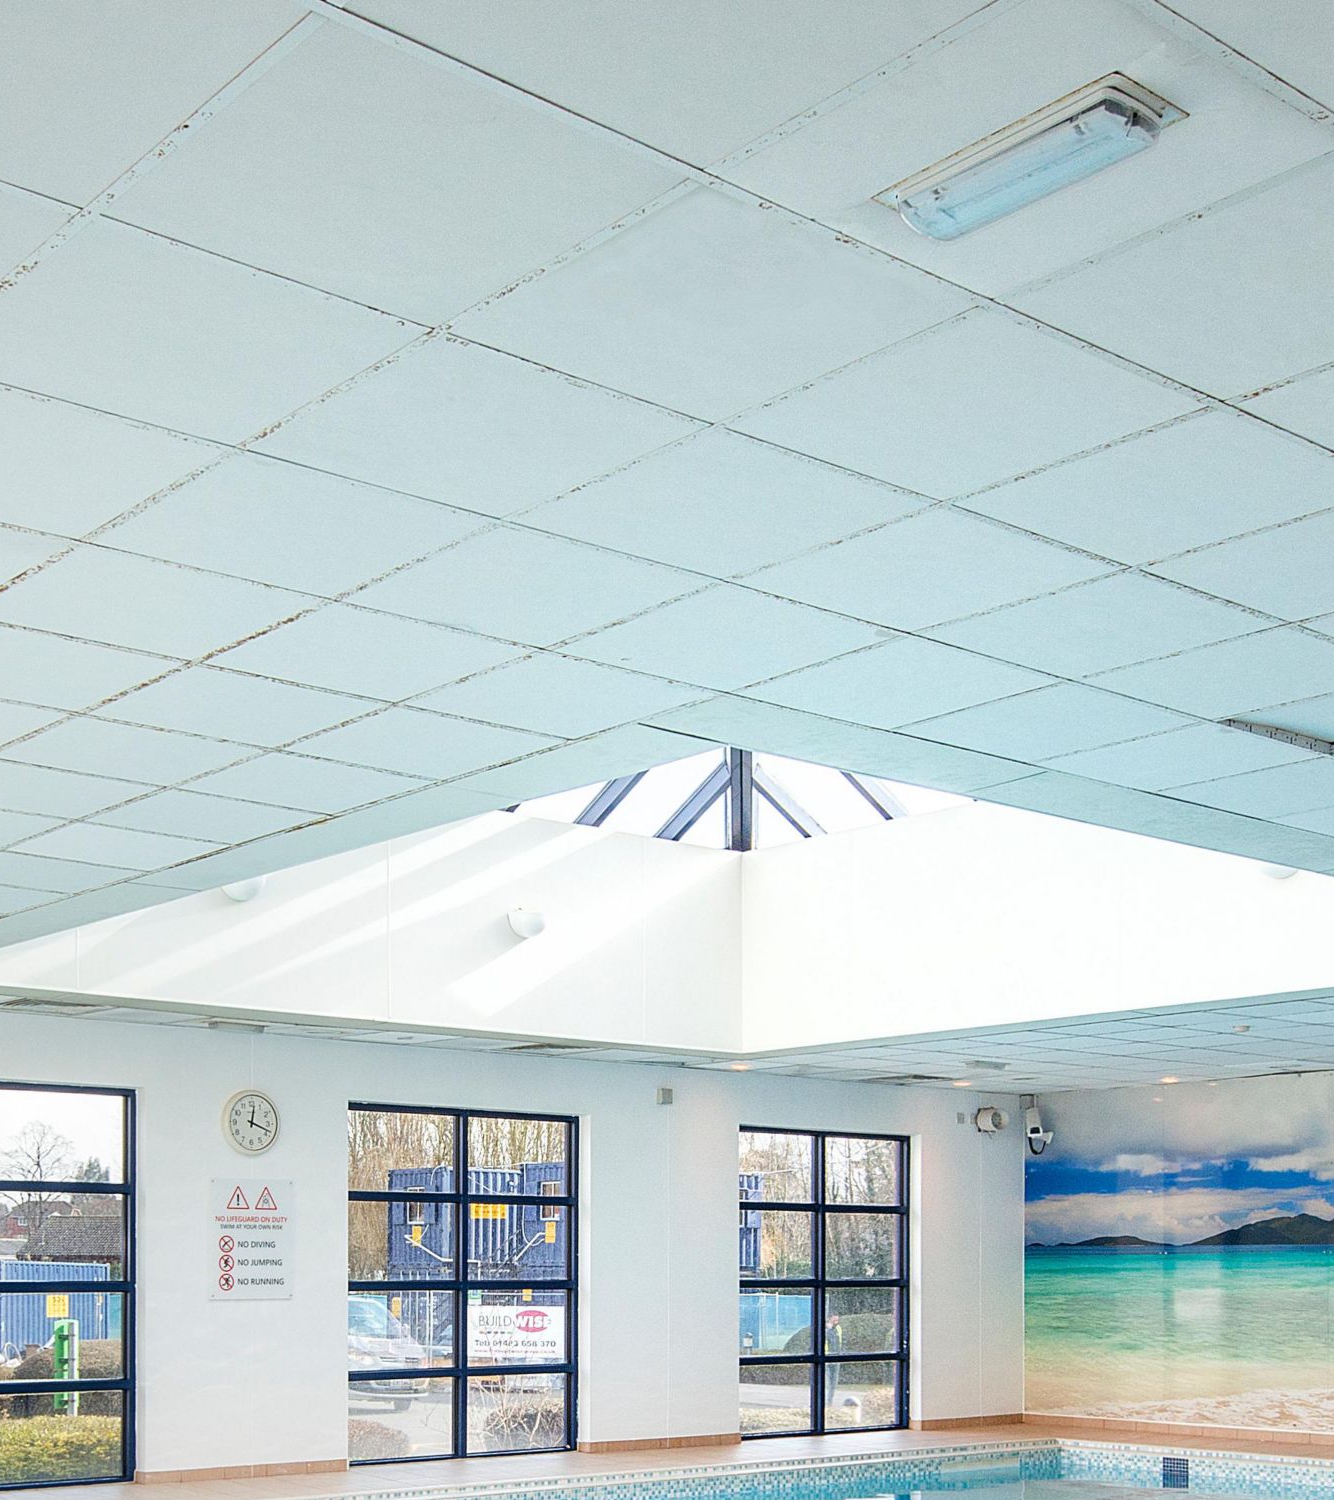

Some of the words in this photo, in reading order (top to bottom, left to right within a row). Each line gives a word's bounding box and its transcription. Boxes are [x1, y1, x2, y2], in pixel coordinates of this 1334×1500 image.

[227, 1215, 260, 1223] LIFEGUARD
[250, 1241, 276, 1249] DIVING
[250, 1259, 283, 1267] JUMPING
[237, 1278, 249, 1286] NO
[250, 1278, 285, 1286] RUNNING
